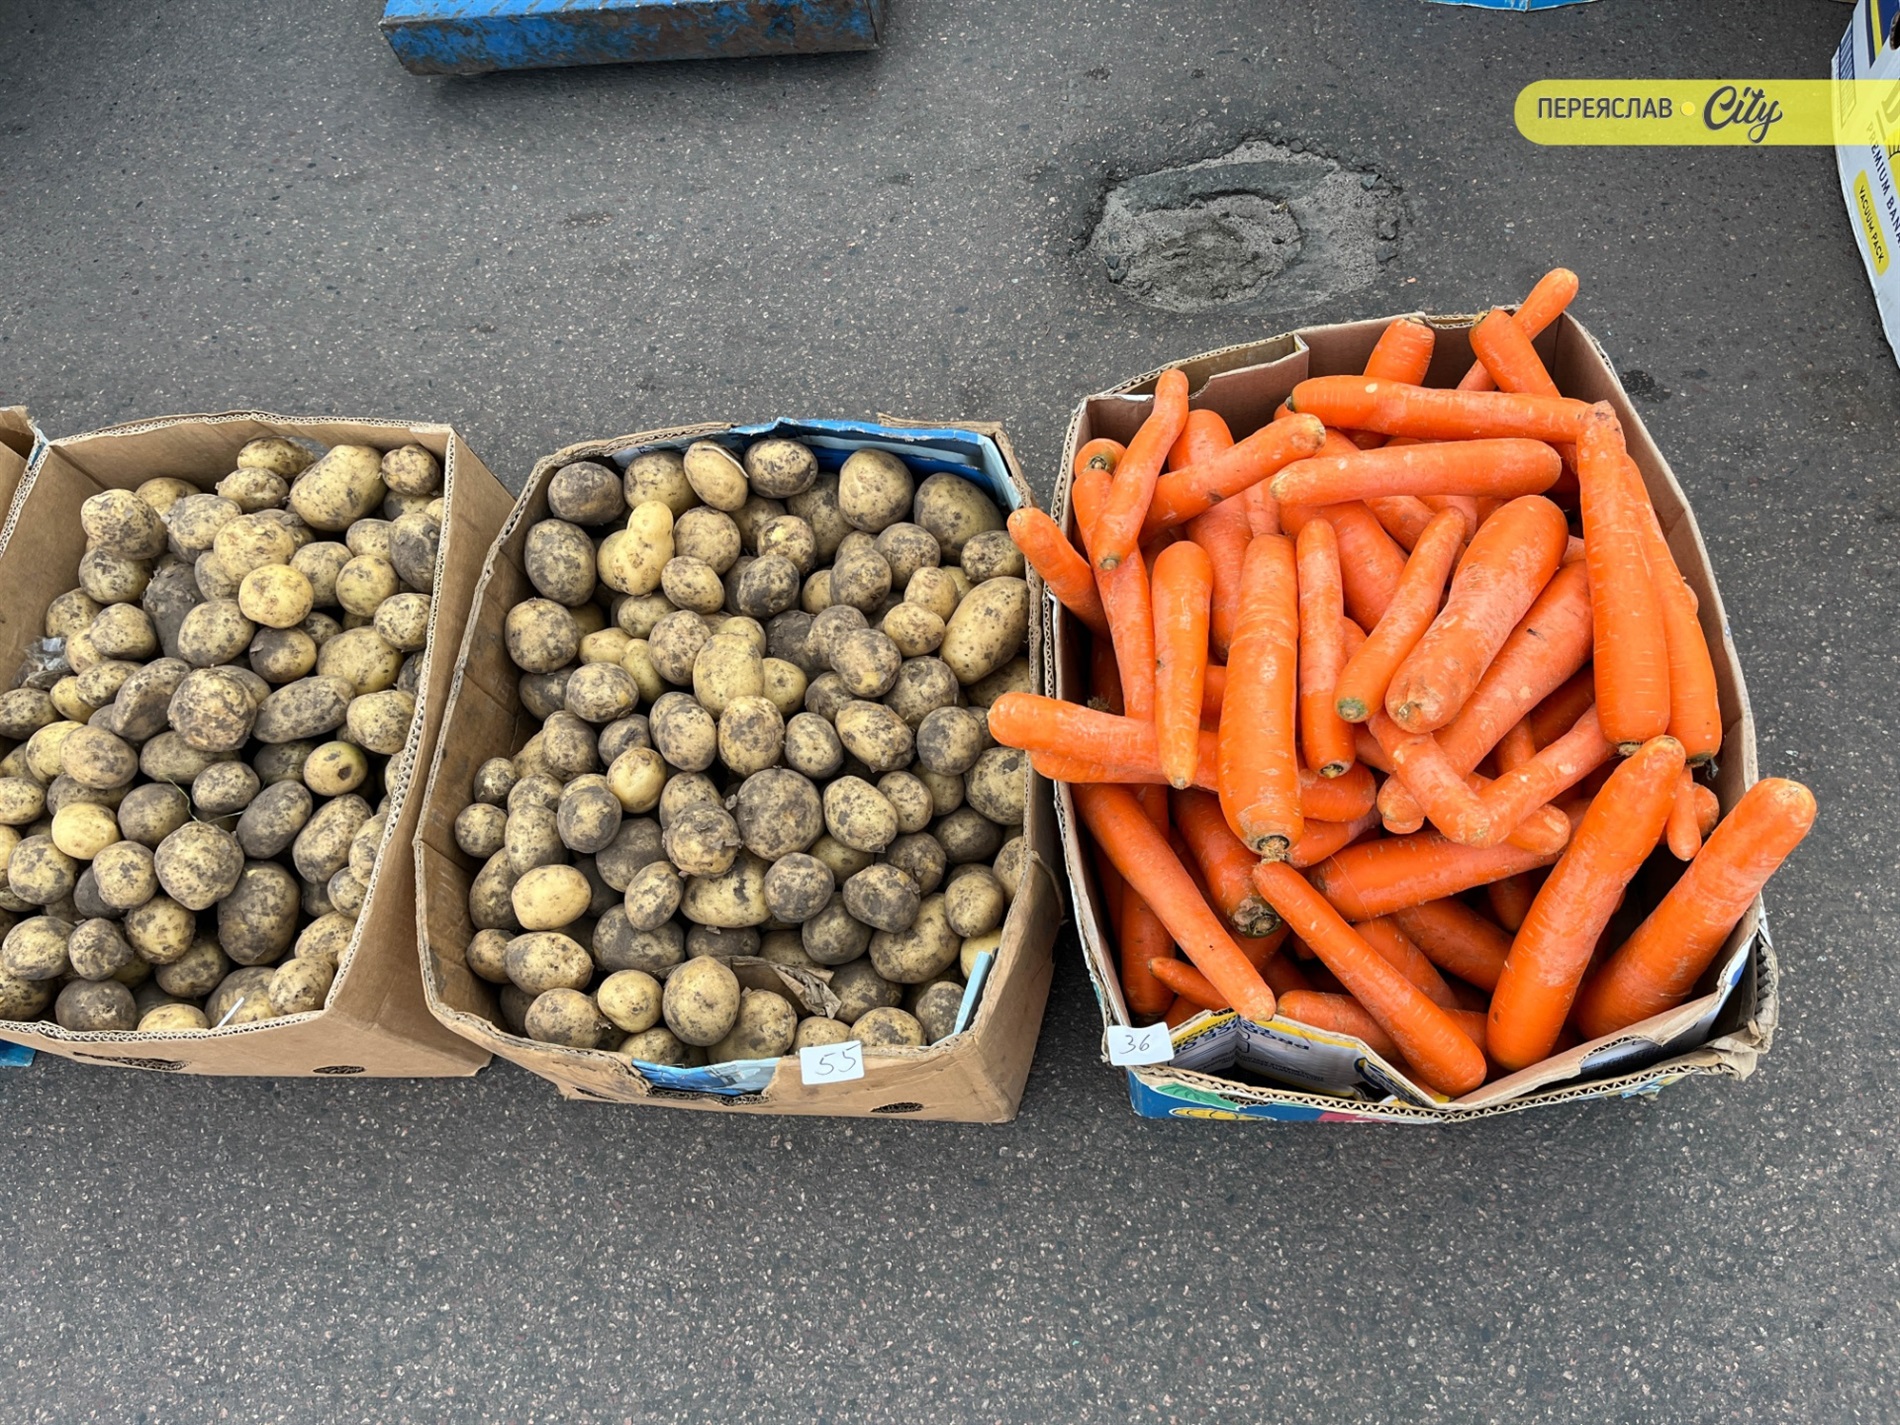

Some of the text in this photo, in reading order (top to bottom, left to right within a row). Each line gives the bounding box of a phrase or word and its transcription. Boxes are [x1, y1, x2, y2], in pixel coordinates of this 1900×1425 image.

[1859, 185, 1884, 263] VACUUM PACK
[1886, 195, 1900, 248] BANA
[815, 1045, 858, 1075] 55
[1120, 1034, 1150, 1054] 36
